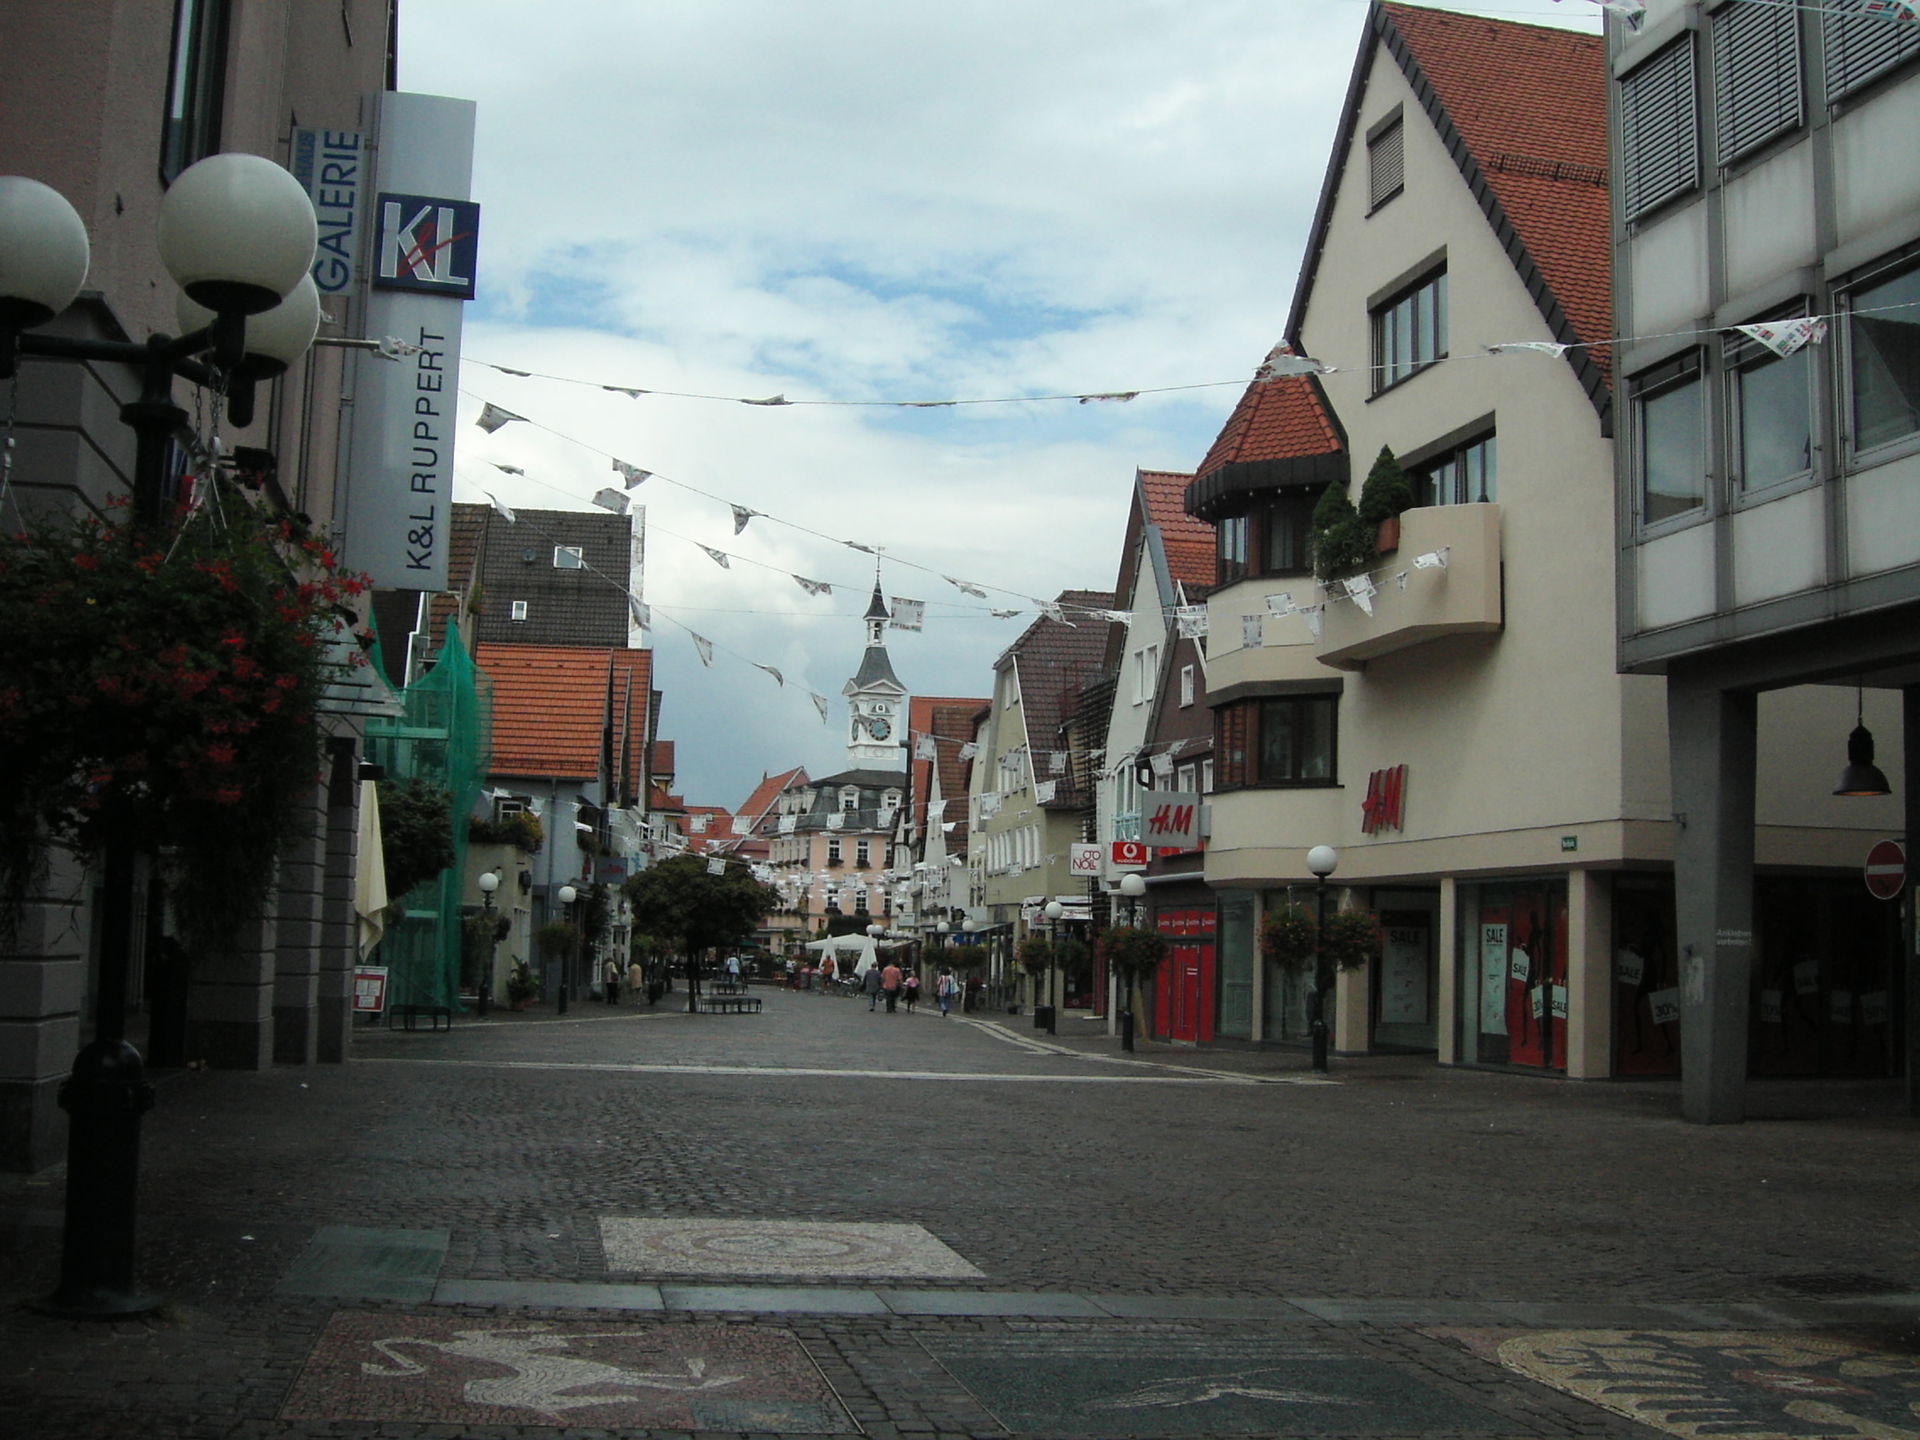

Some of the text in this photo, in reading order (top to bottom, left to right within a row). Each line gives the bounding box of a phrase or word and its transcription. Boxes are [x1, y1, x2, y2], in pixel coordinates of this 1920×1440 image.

[313, 131, 359, 291] GALERIE
[407, 326, 445, 571] K&L RUPPERT
[1149, 804, 1194, 836] H&M
[1390, 930, 1421, 945] SALE
[1486, 928, 1504, 944] SALE
[1512, 962, 1528, 977] SALE
